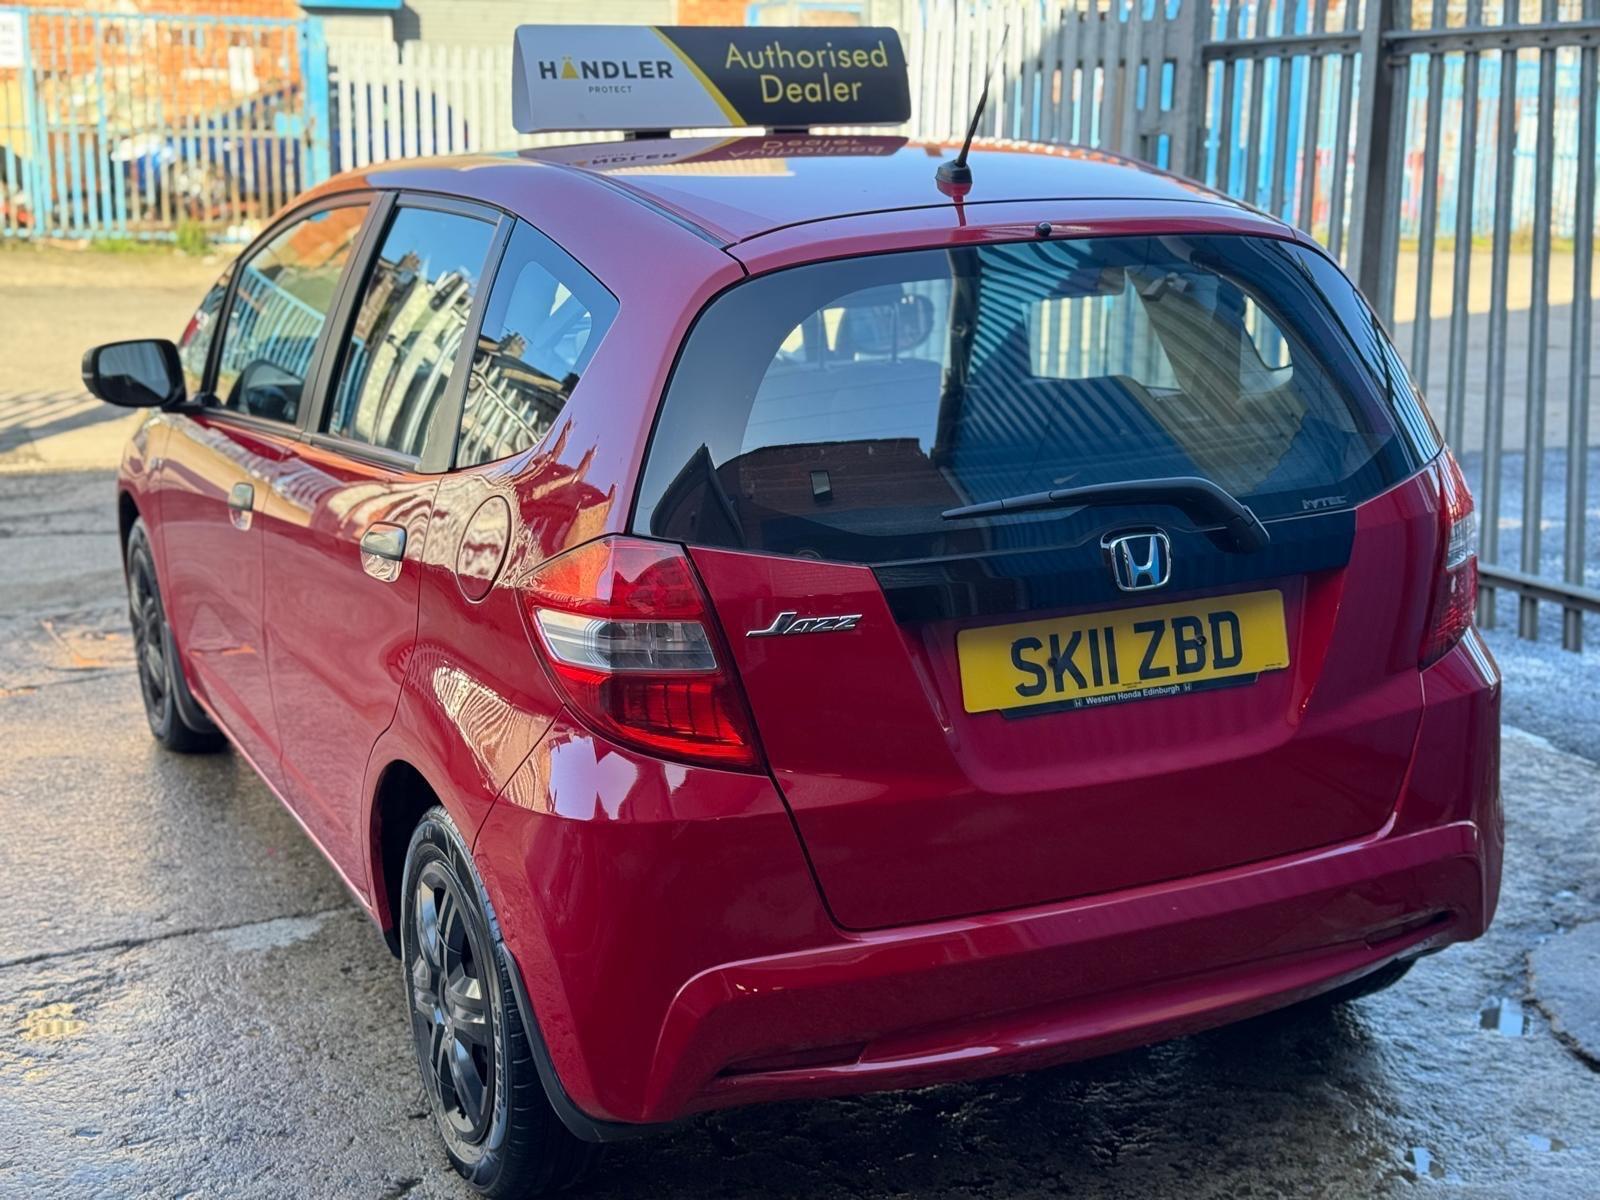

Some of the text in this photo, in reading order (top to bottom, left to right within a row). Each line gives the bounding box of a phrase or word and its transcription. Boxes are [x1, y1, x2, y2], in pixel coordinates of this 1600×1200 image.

[725, 40, 889, 69] Authorised
[588, 85, 632, 94] PROTECT
[760, 72, 863, 104] Dealer
[1010, 610, 1243, 698] SK11 ZBD
[1086, 695, 1116, 704] Western
[1118, 690, 1141, 700] Honda
[1143, 685, 1180, 697] Edinburgh
